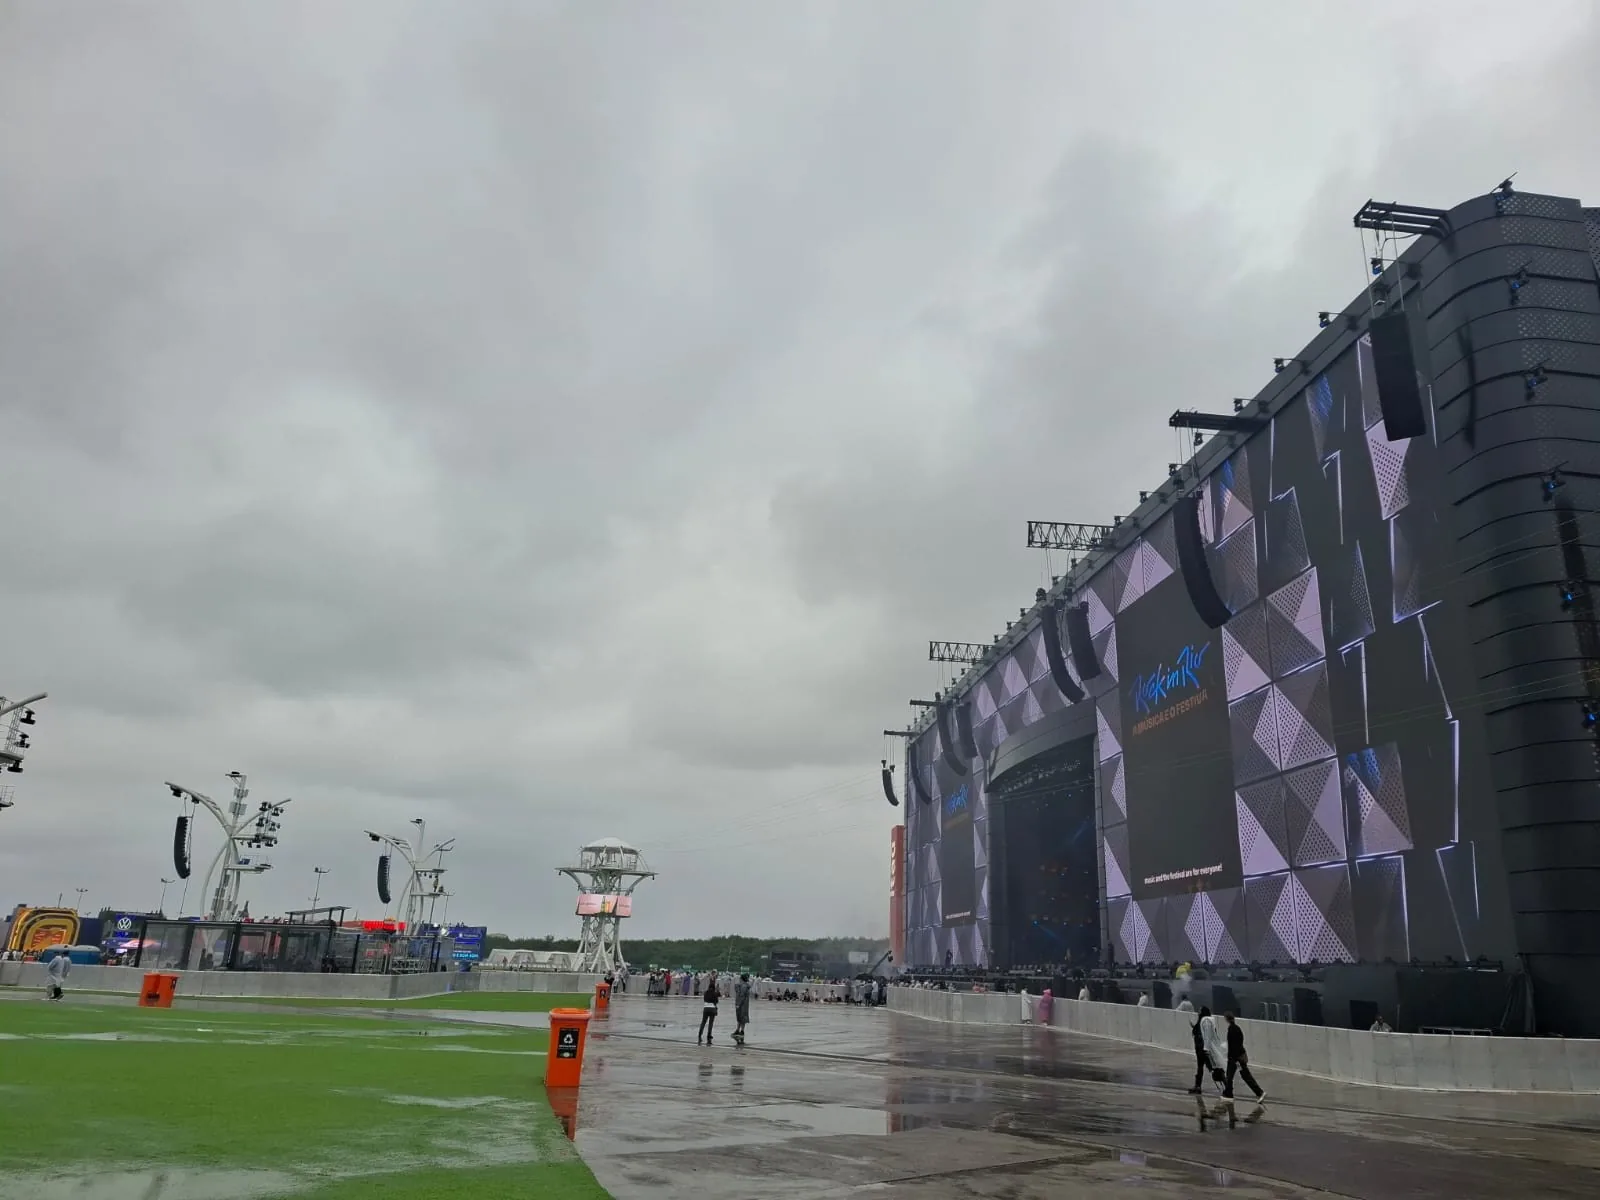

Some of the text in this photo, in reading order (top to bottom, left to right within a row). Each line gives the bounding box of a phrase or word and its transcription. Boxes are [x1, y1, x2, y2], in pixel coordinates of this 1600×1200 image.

[1128, 641, 1210, 714] Rock in Rio
